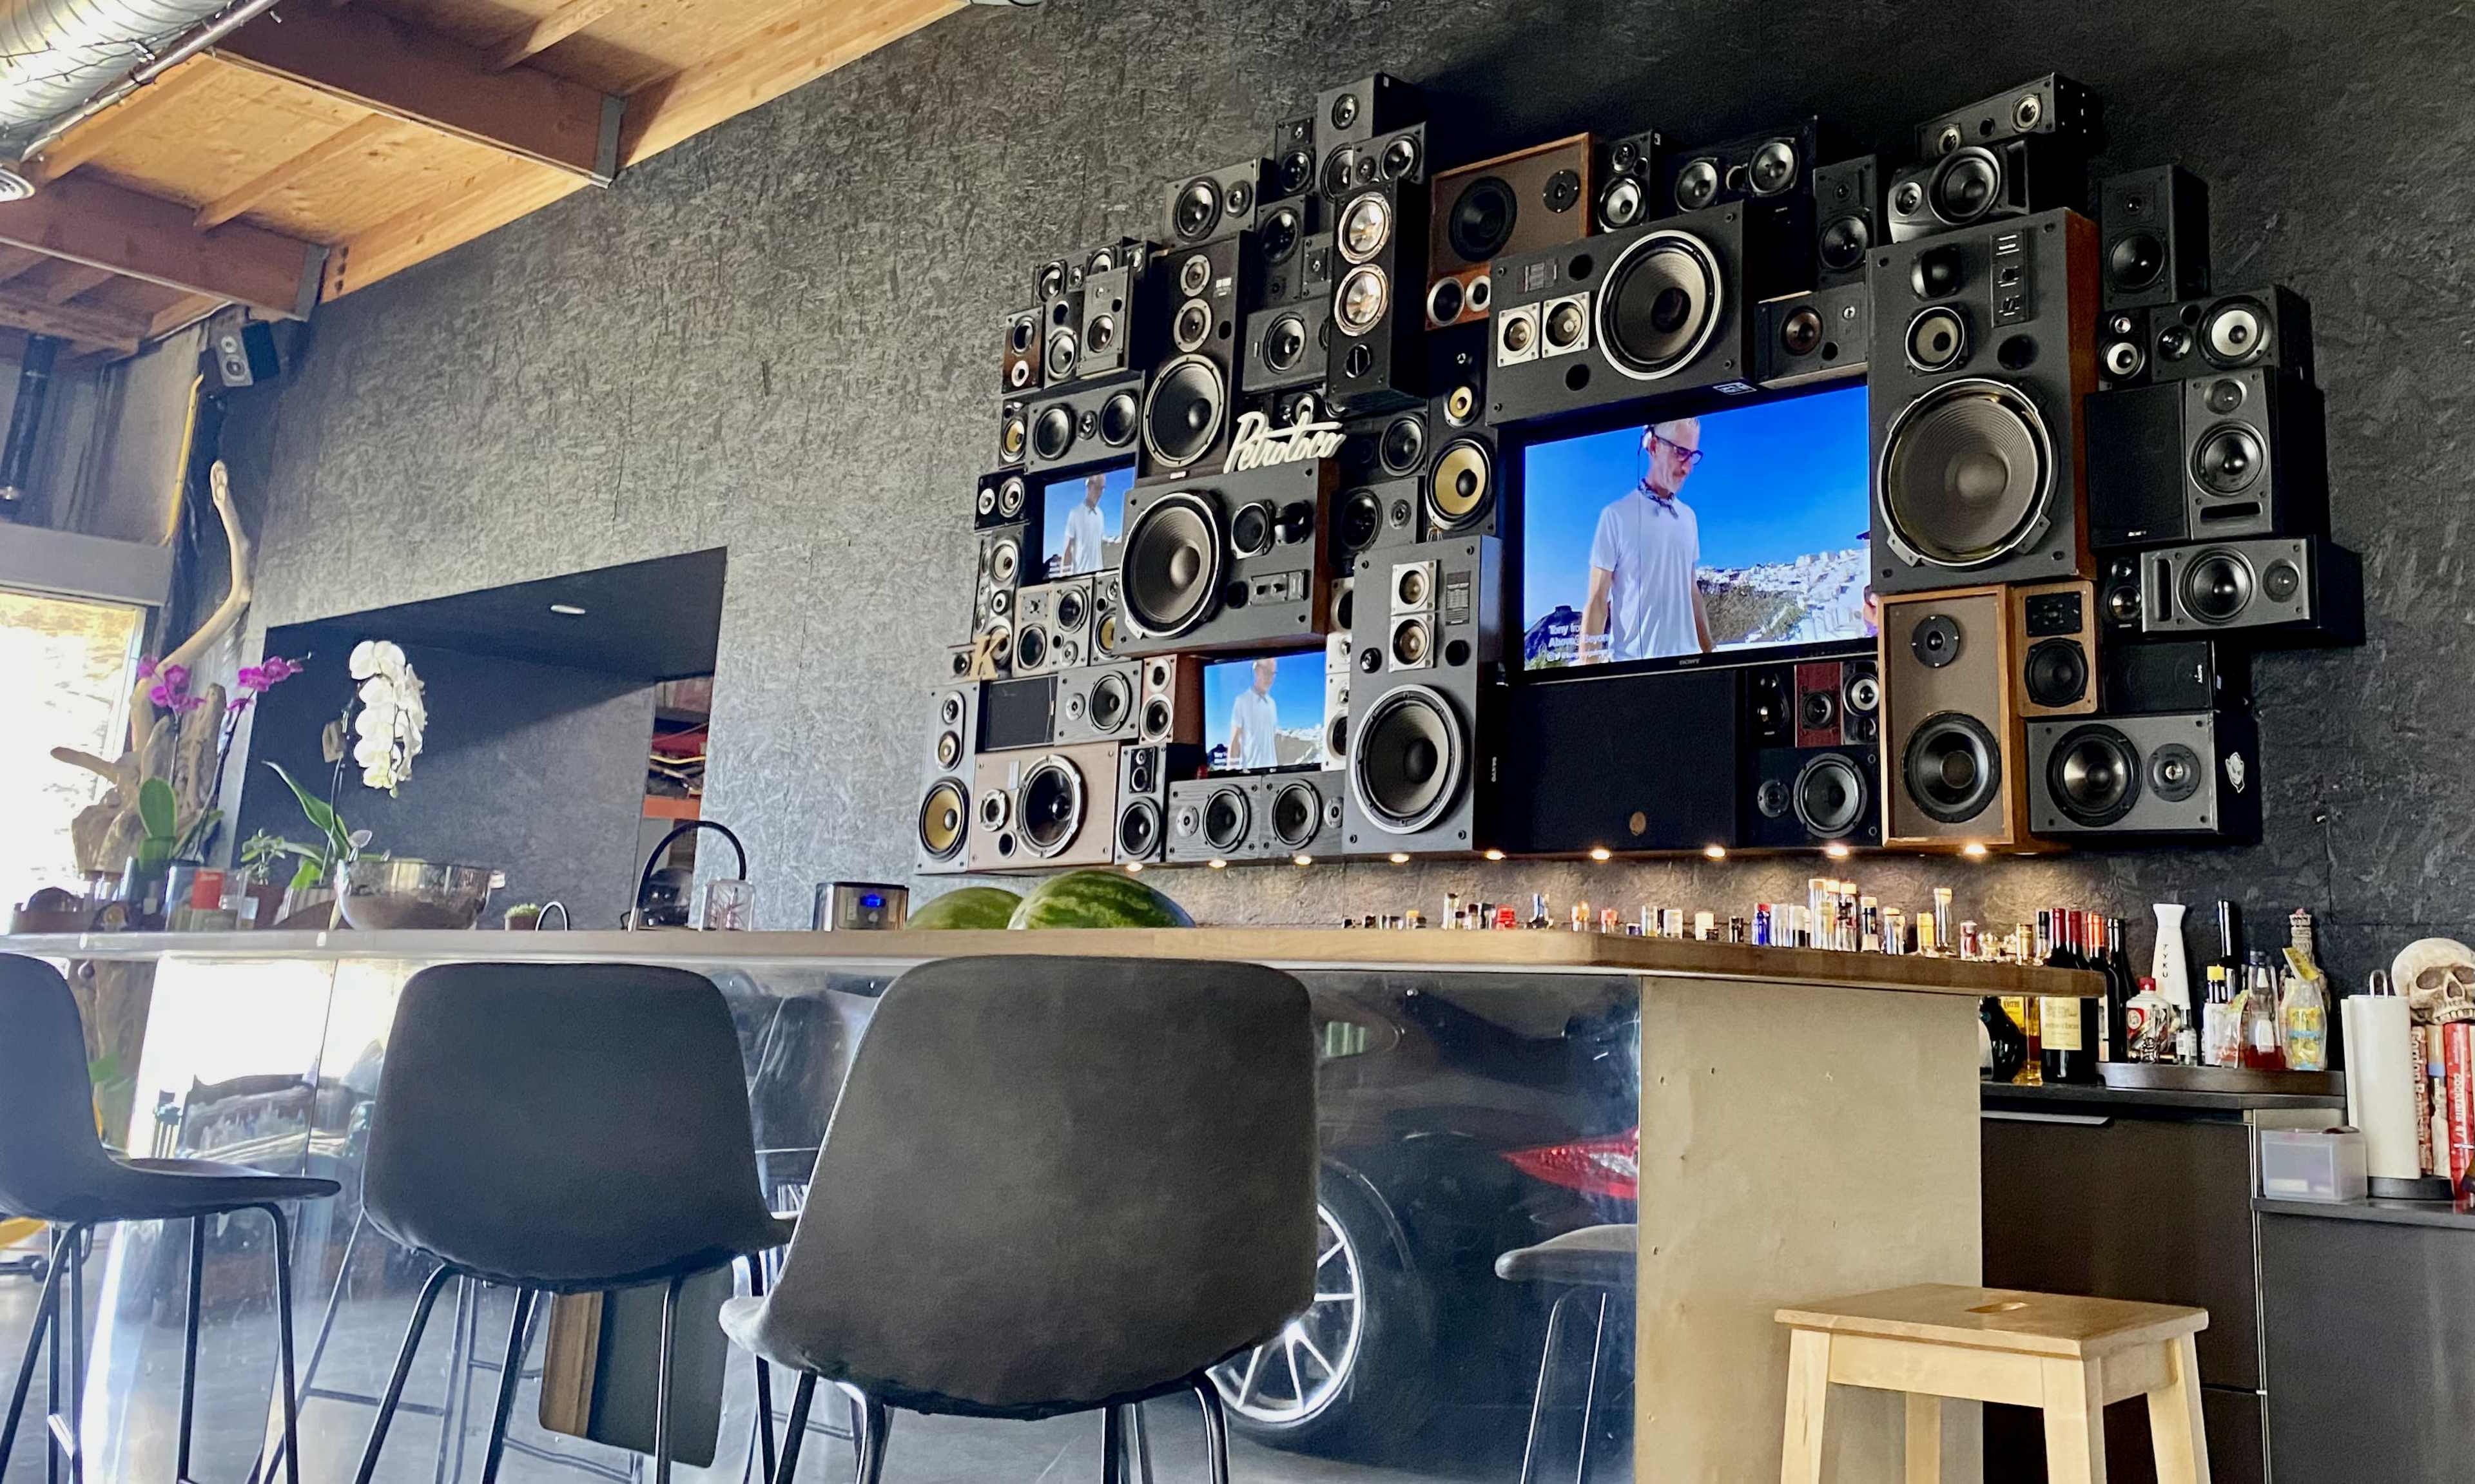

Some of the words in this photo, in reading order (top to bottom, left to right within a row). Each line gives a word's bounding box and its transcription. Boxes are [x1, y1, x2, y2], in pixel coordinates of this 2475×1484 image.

[968, 628, 1009, 681] K
[1548, 624, 1569, 636] Tony
[1570, 623, 1583, 633] fro
[2412, 1030, 2423, 1081] Gordon
